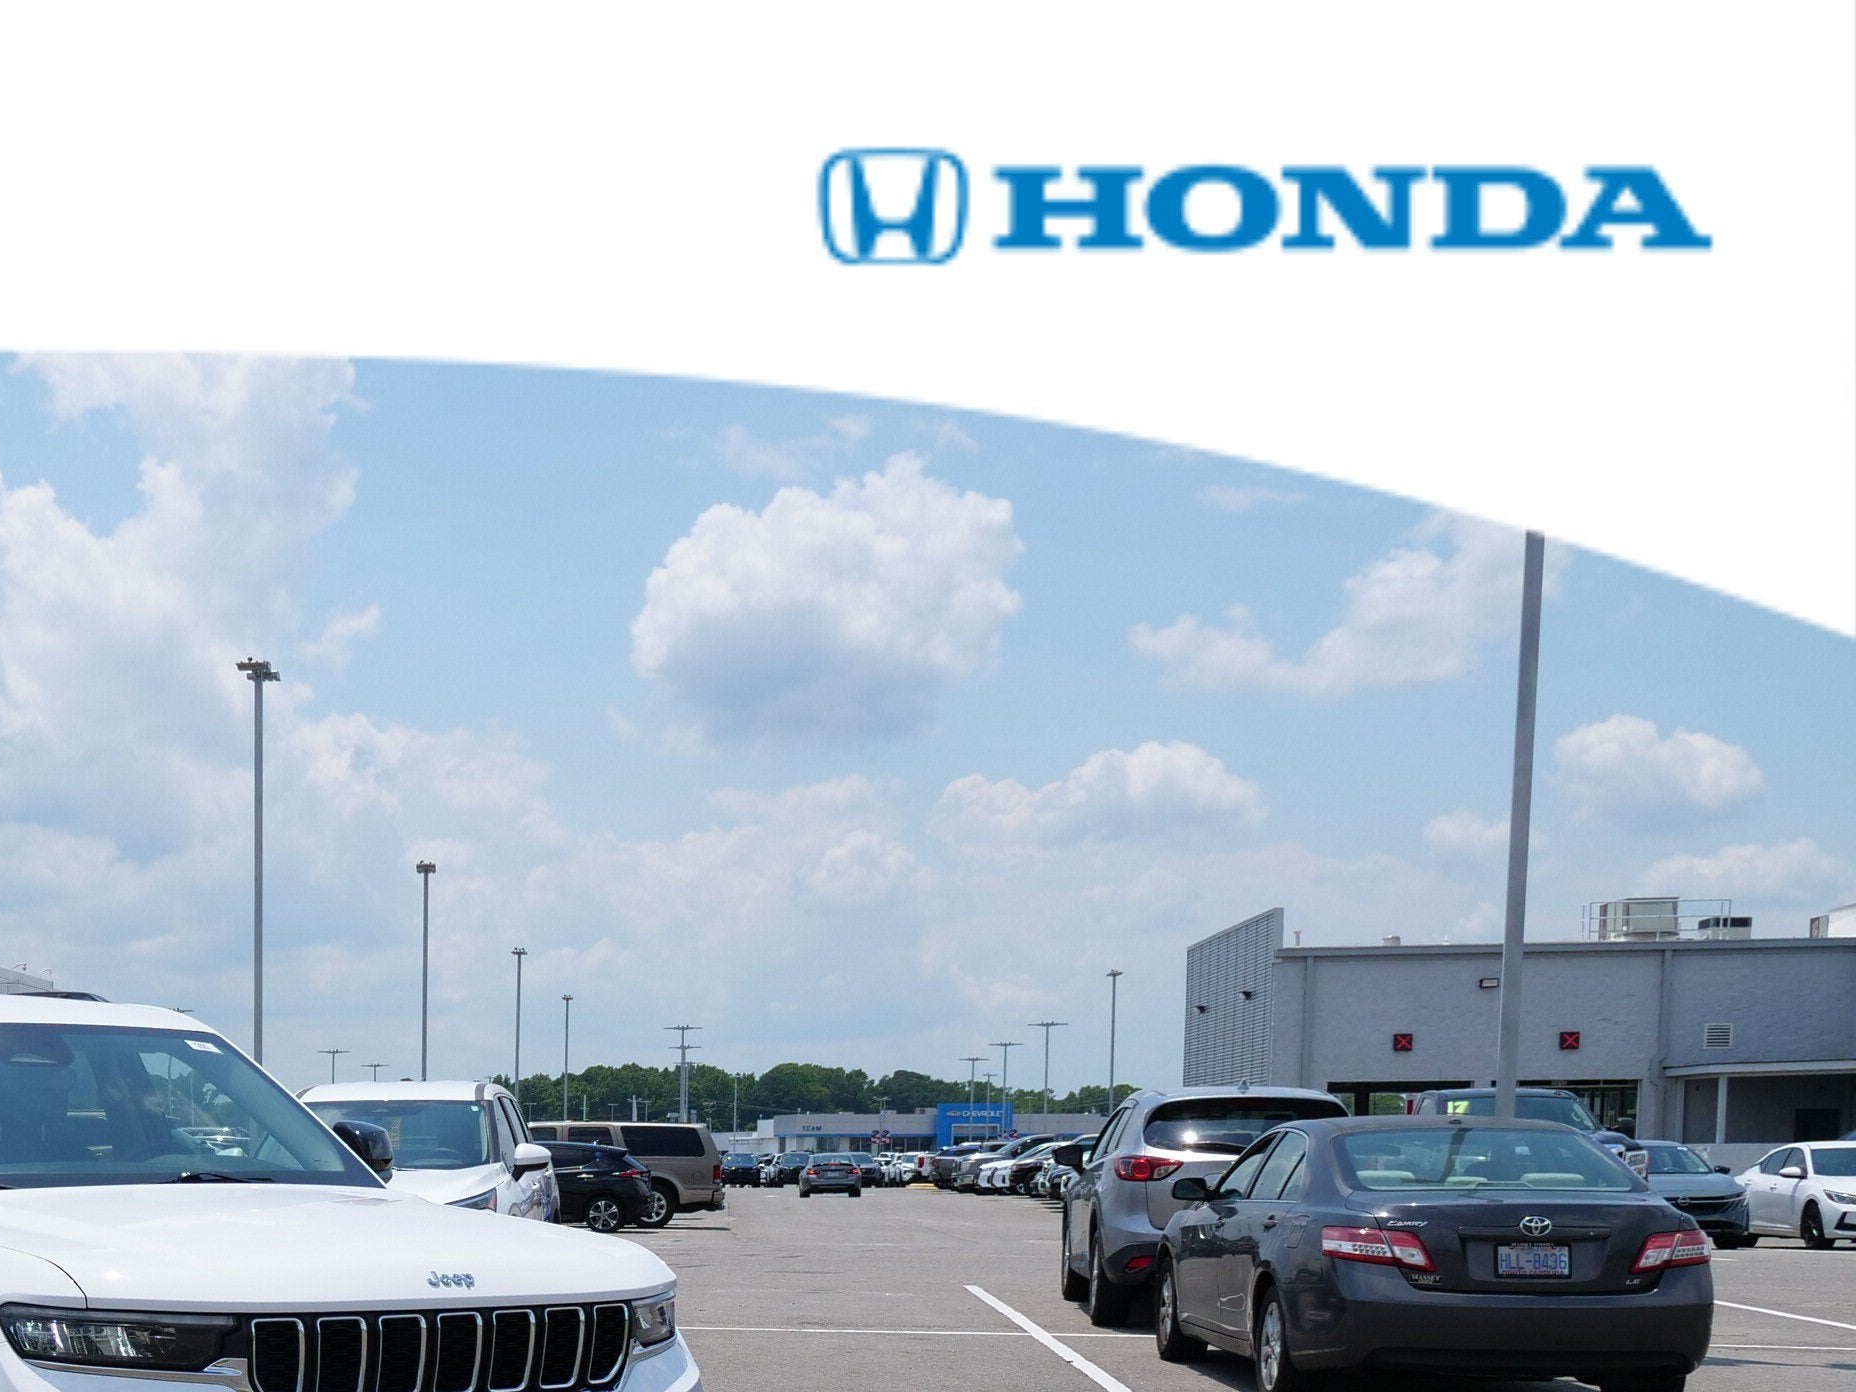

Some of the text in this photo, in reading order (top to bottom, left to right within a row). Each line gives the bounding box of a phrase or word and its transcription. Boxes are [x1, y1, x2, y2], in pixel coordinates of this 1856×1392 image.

[1446, 1100, 1470, 1114] 17
[1500, 1252, 1567, 1270] HLL-8436
[426, 1270, 476, 1291] Jeep
[1410, 1273, 1441, 1282] MASSEY
